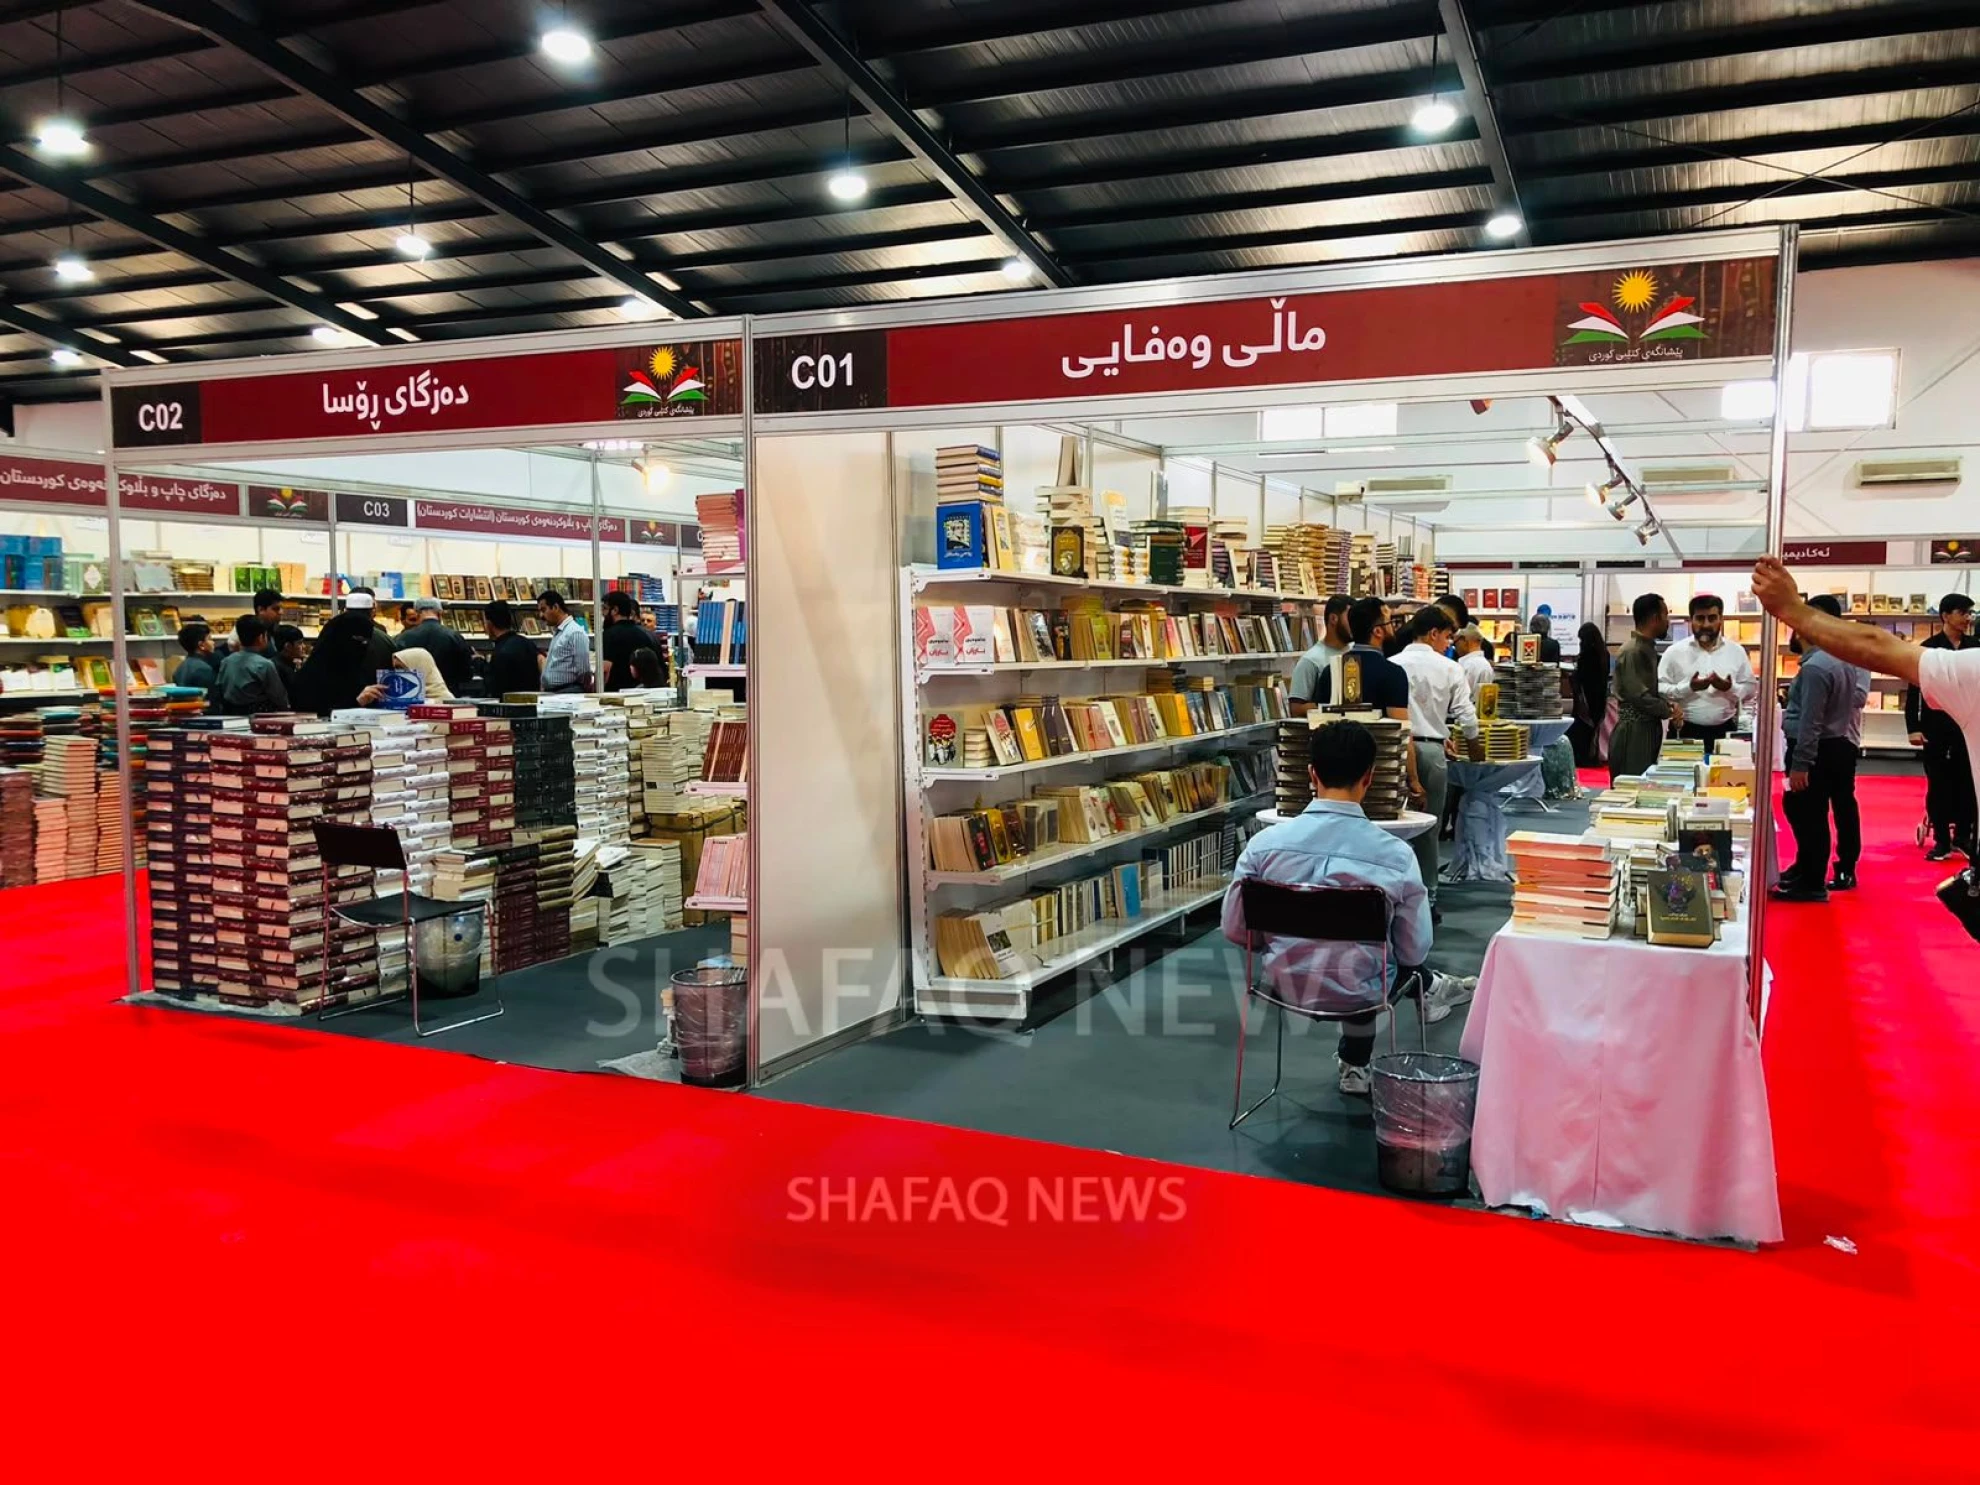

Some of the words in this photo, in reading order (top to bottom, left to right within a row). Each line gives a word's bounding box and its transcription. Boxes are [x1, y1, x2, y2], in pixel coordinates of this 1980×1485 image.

[1222, 297, 1326, 367] ماڵی
[1062, 324, 1211, 378] وەفایی
[791, 352, 853, 389] C01
[322, 381, 381, 430] ڕۆسا
[385, 369, 469, 415] دەزگای
[139, 402, 183, 432] C02
[151, 486, 159, 497] و
[161, 482, 186, 502] چاپ
[364, 500, 390, 517] C03
